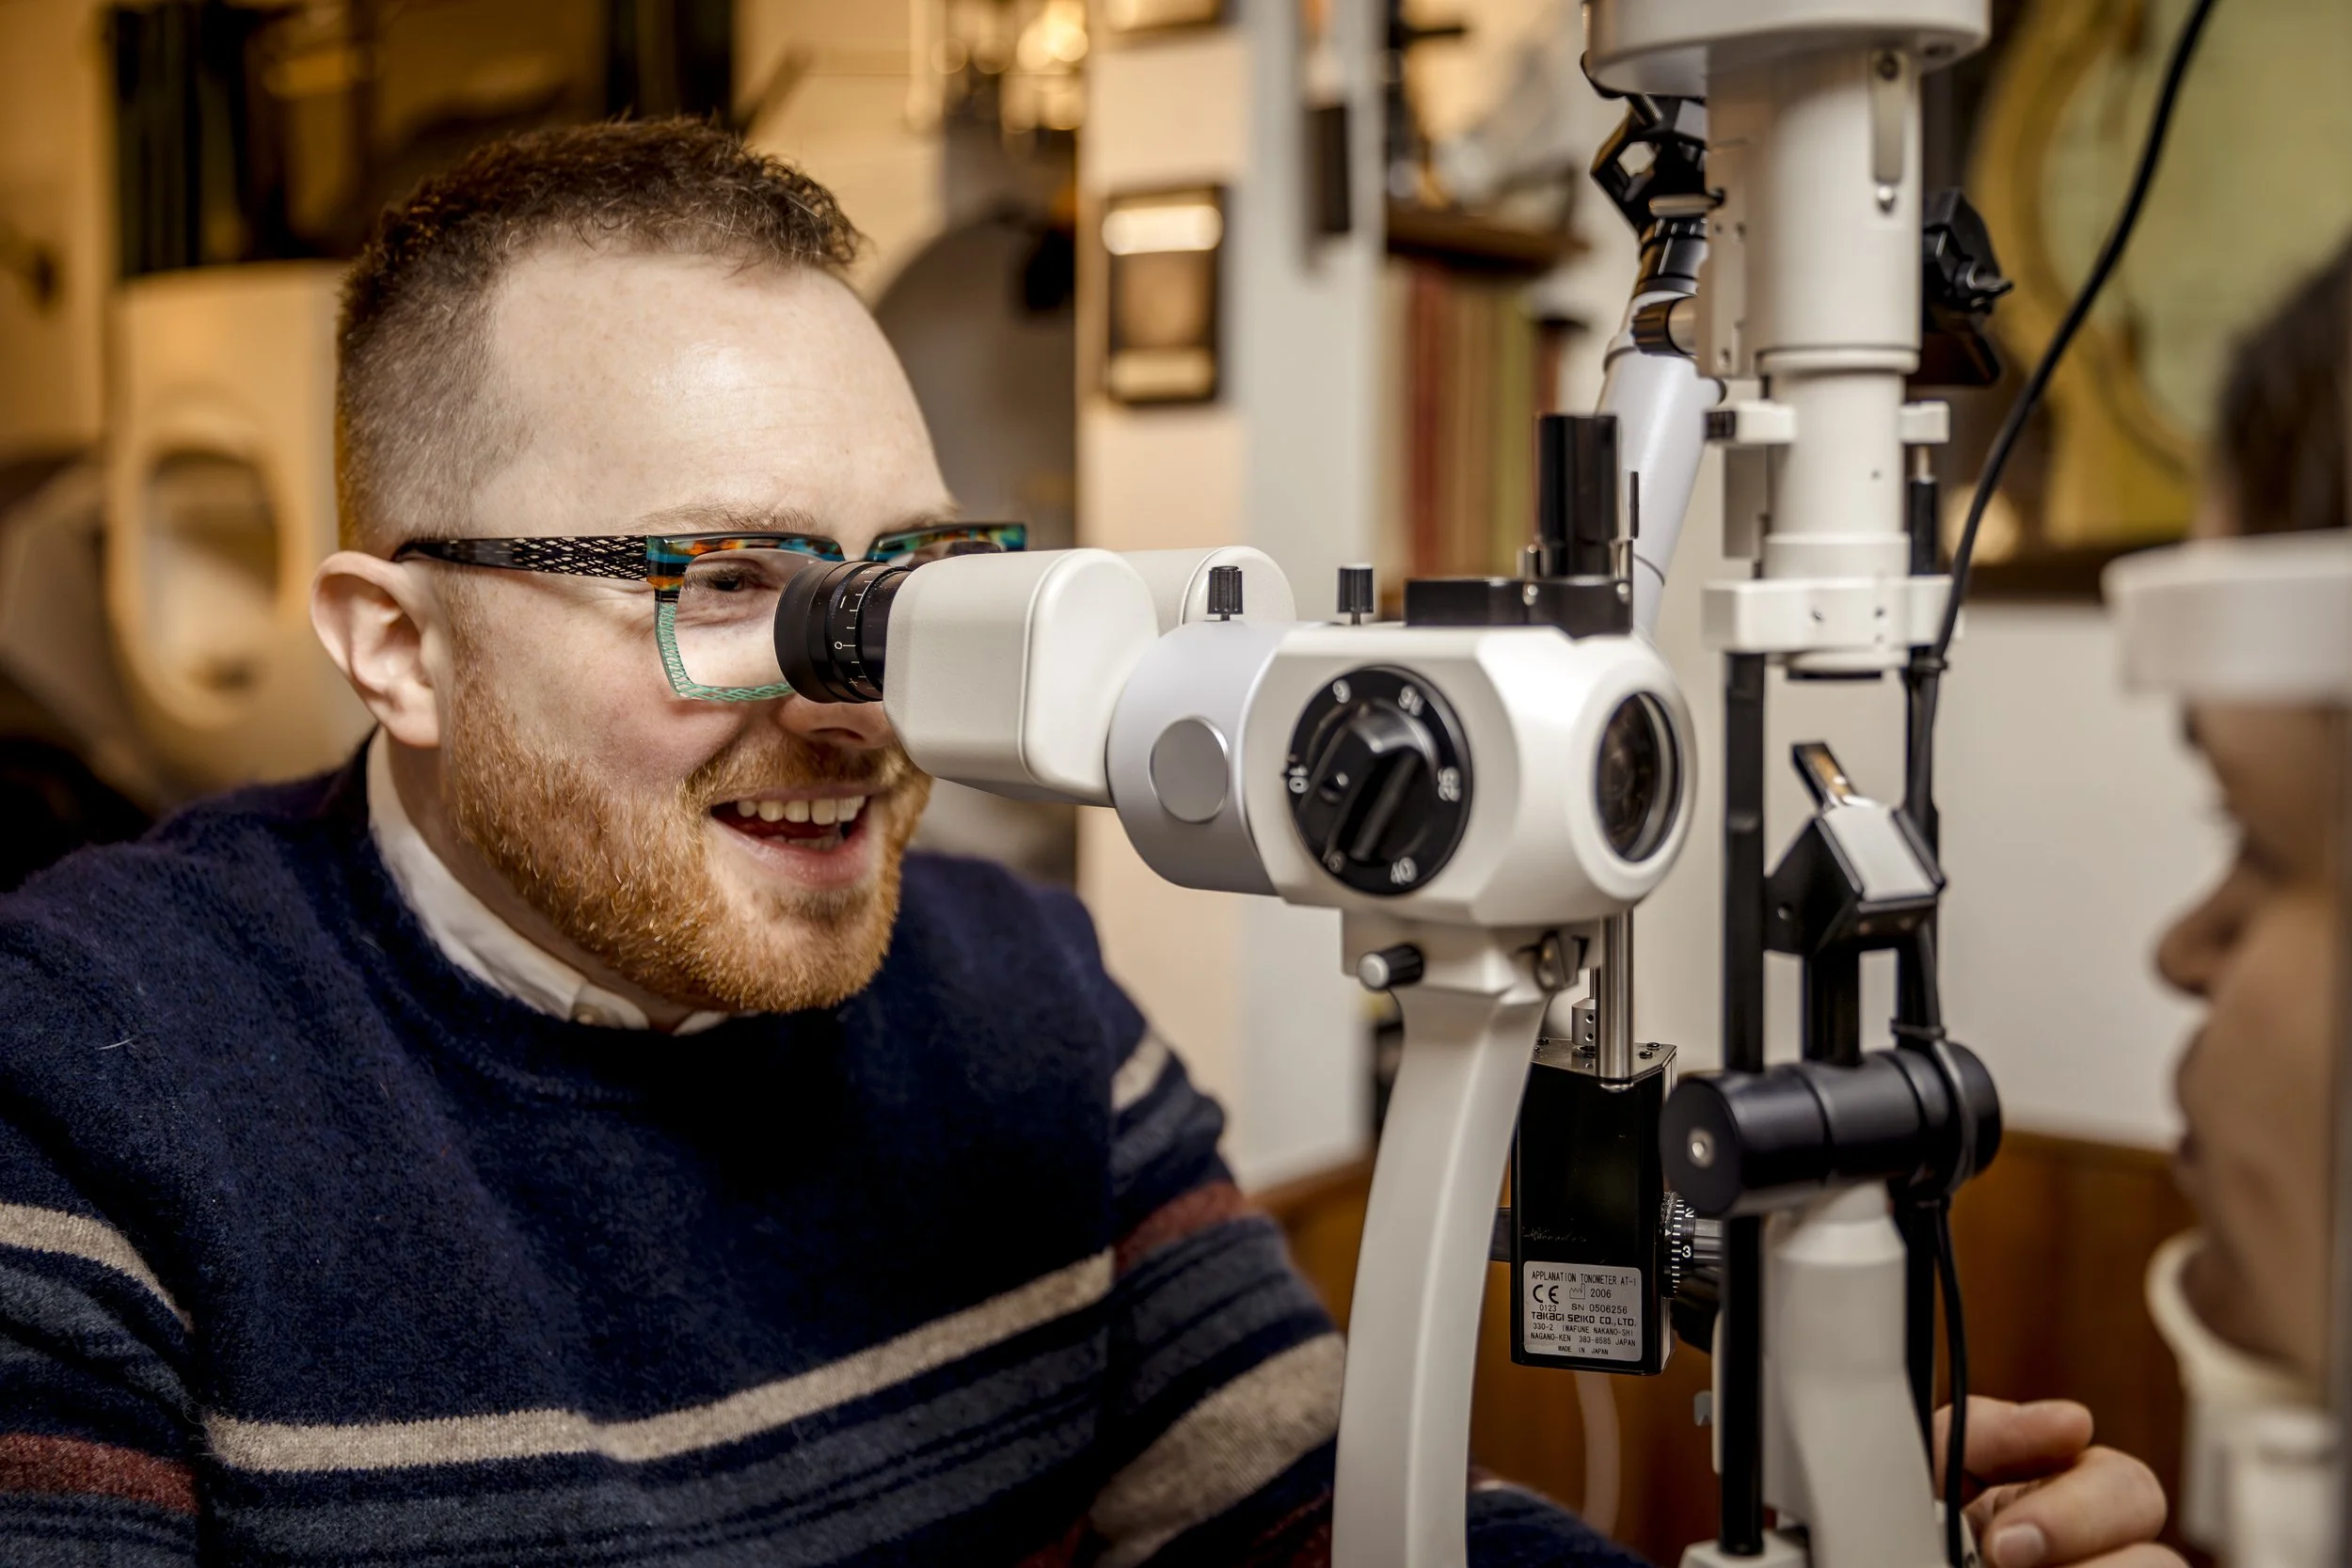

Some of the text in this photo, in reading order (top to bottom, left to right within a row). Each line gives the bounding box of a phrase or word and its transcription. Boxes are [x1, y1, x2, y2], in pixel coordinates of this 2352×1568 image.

[1391, 857, 1417, 885] 40
[1684, 1207, 1694, 1218] 2
[1681, 1244, 1692, 1258] 3
[1532, 1271, 1577, 1282] APPLANATION
[1581, 1274, 1617, 1285] TONOMETER
[1590, 1288, 1612, 1299] 2006
[1539, 1304, 1557, 1312] 0123
[1571, 1303, 1628, 1314] SN 0506256
[1533, 1323, 1633, 1337] 330-2 IWAFUNE NAKANO-SHI
[1530, 1332, 1636, 1347] NAGANO-KEN 383-8585 JAPAN
[1591, 1347, 1609, 1355] JAPAN
